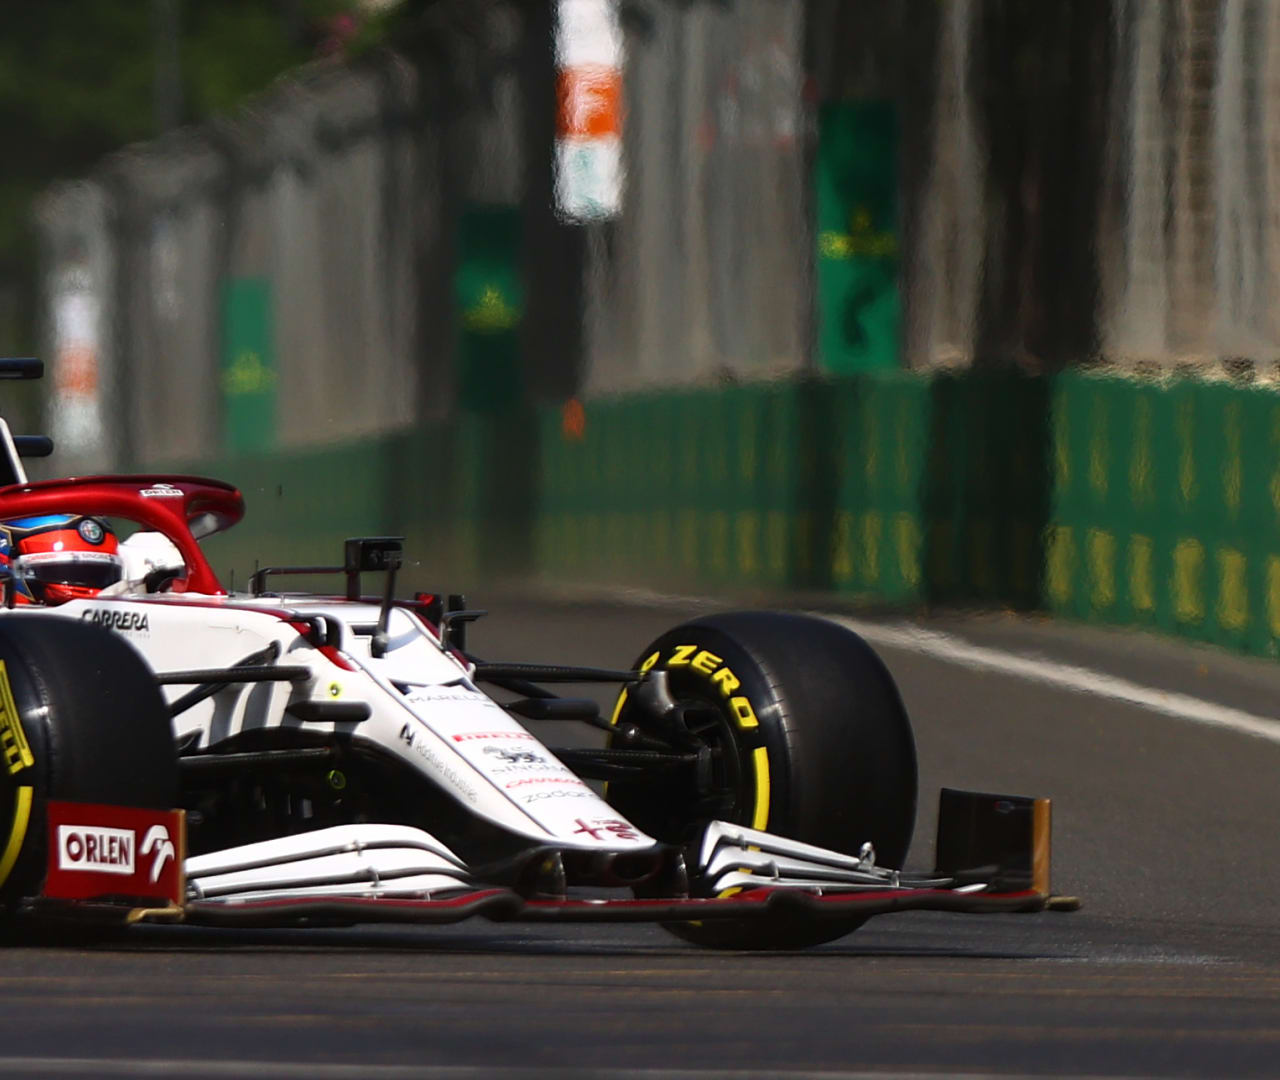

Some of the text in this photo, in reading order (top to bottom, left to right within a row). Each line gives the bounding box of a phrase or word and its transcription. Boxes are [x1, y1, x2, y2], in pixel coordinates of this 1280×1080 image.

[82, 609, 150, 632] CARRERA
[667, 645, 759, 728] ZERO
[66, 832, 131, 866] ORLEN
